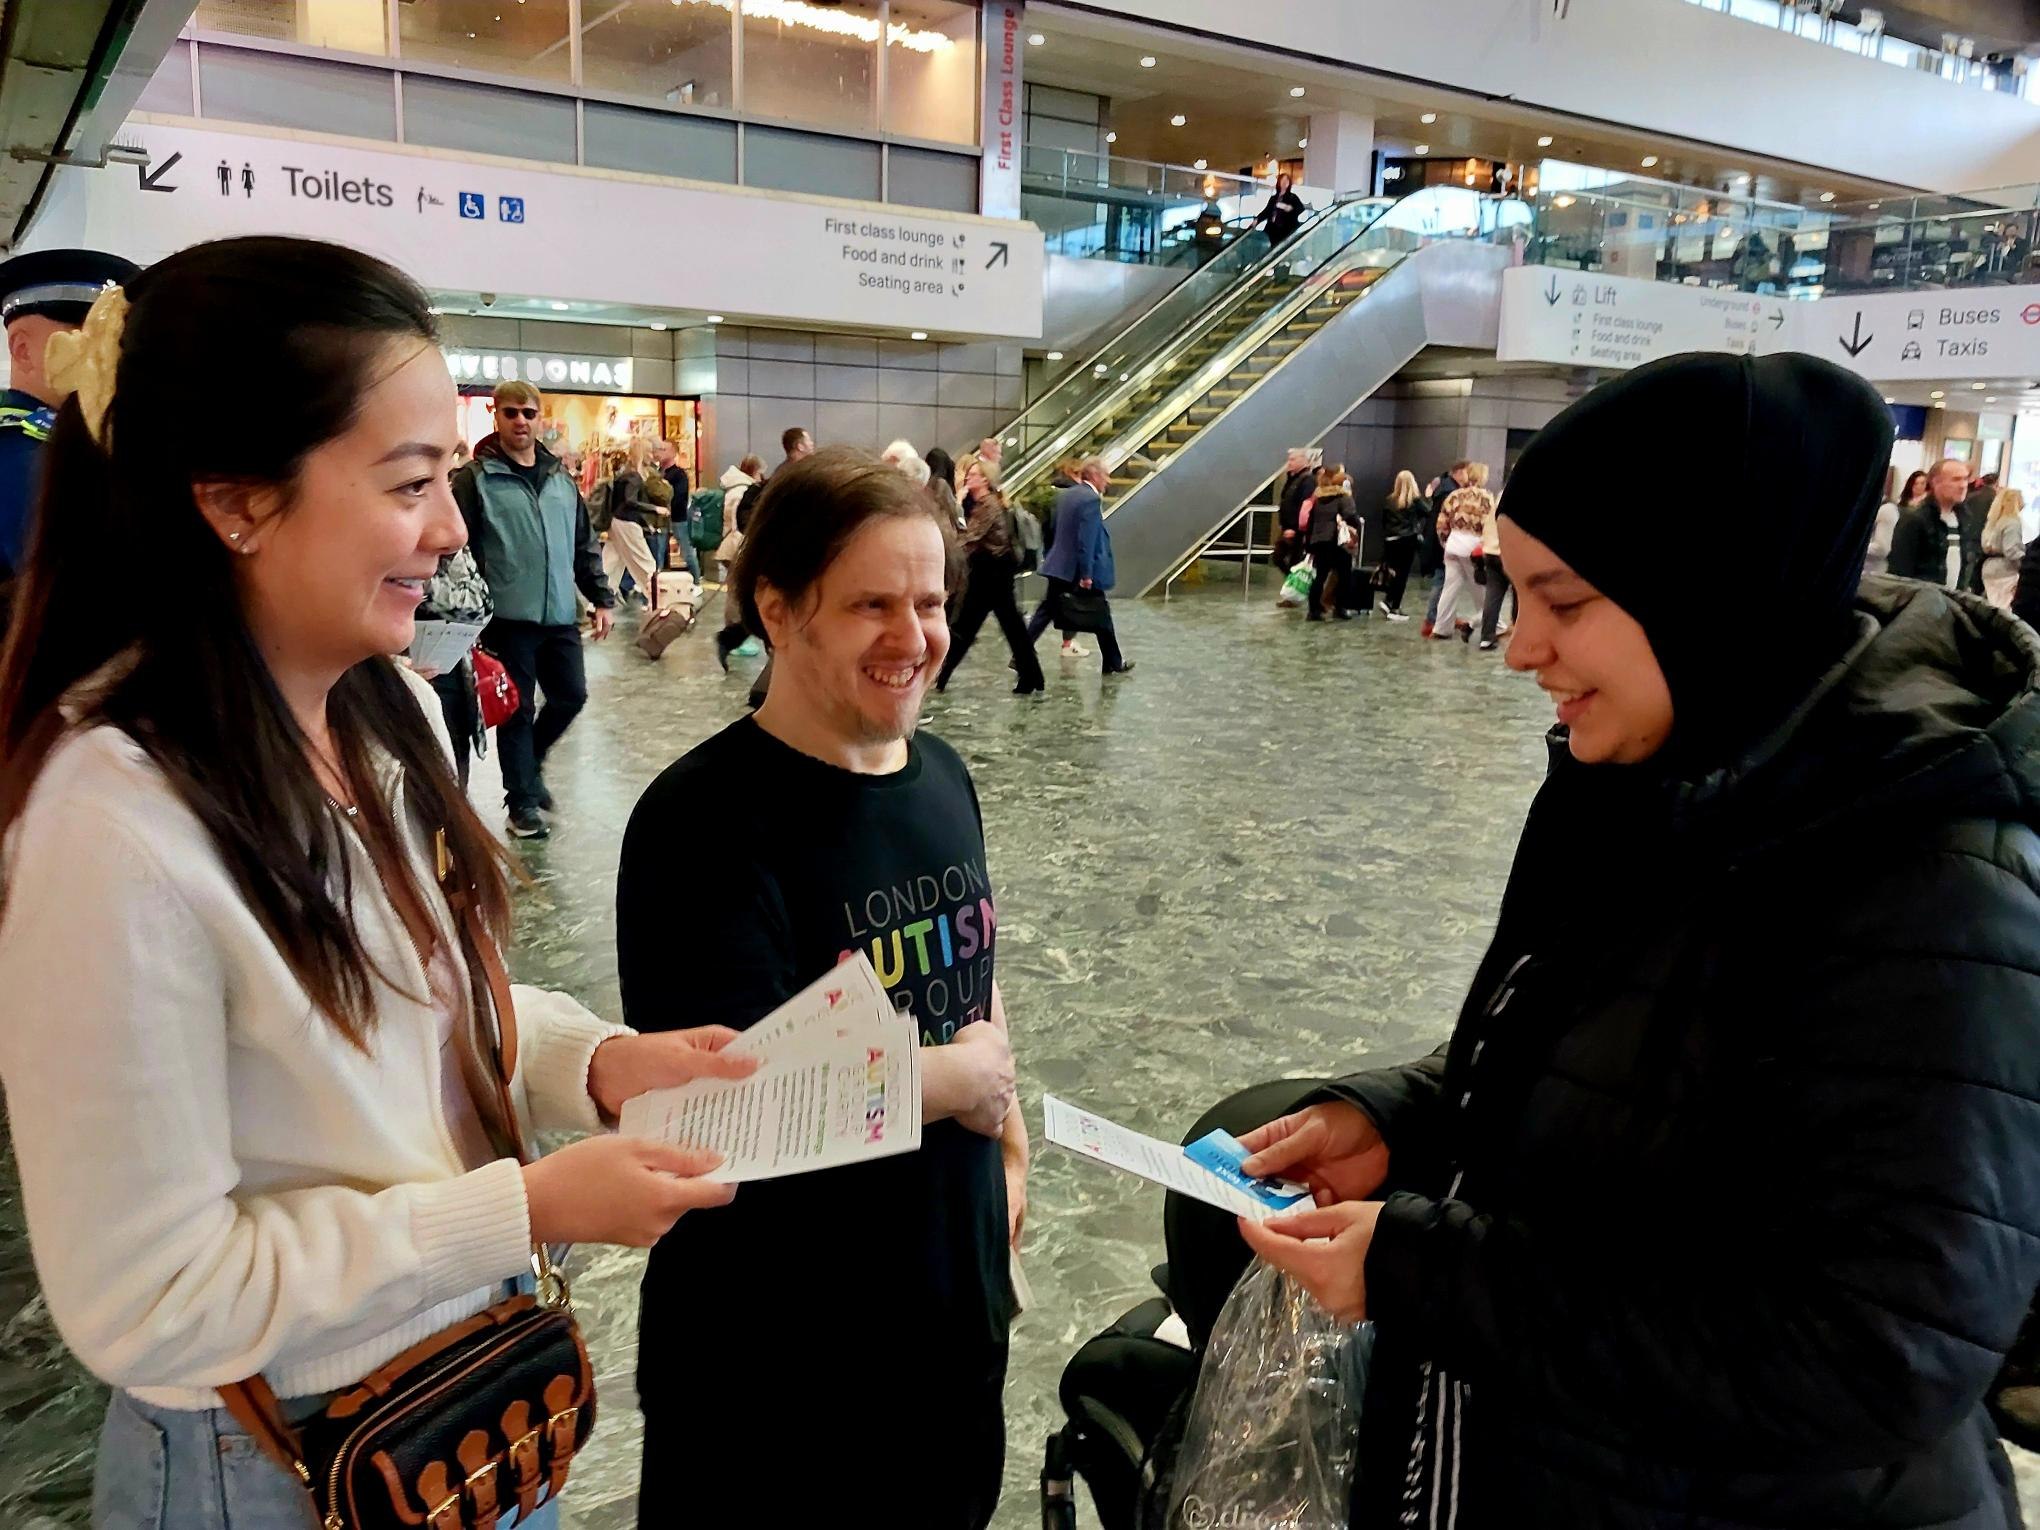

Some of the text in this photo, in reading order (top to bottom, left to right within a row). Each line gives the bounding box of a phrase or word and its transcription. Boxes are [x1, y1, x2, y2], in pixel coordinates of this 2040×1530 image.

[997, 7, 1019, 171] First Class Lounge
[281, 166, 394, 207] Toilets
[825, 218, 944, 249] First class lounge
[842, 245, 944, 269] Food and drink
[859, 273, 944, 295] Seating area
[1594, 285, 1617, 306] Lift
[1592, 313, 1664, 335] First class lounge
[1939, 308, 2001, 326] Buses
[1591, 329, 1613, 343] Food
[1937, 338, 1988, 357] Taxis
[527, 357, 629, 387] BONAS
[844, 857, 985, 939] LONDON
[893, 955, 990, 1014] ROUP
[865, 1046, 886, 1144] AUTISM
